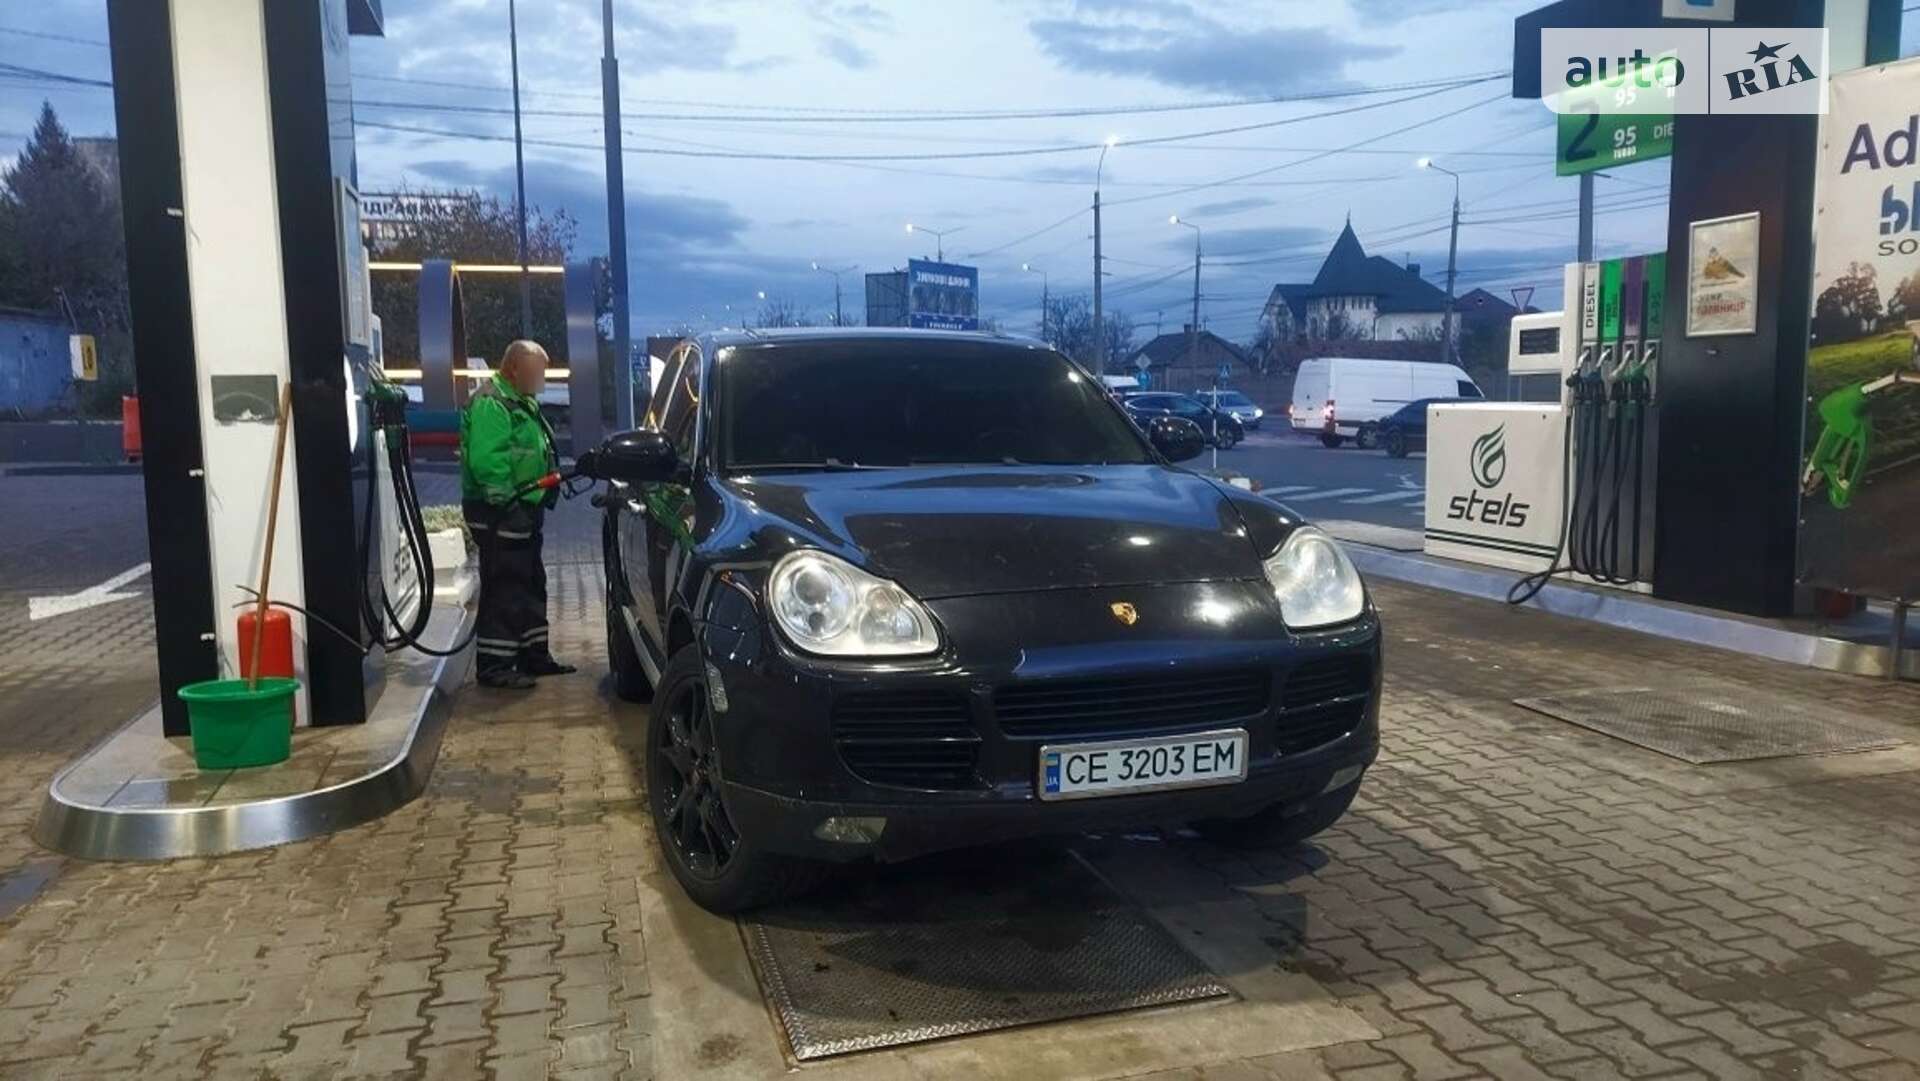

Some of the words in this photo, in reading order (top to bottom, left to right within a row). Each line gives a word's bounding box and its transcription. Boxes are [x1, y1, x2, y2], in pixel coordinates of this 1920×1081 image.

[1615, 86, 1637, 108] 95
[1565, 98, 1600, 163] 2
[1613, 125, 1637, 149] 95
[1840, 114, 1920, 175] Ad
[1585, 281, 1596, 329] DIESEL
[1447, 489, 1530, 527] stels
[1066, 752, 1109, 785] CE
[1118, 746, 1185, 781] 3203
[1193, 741, 1236, 774] EM
